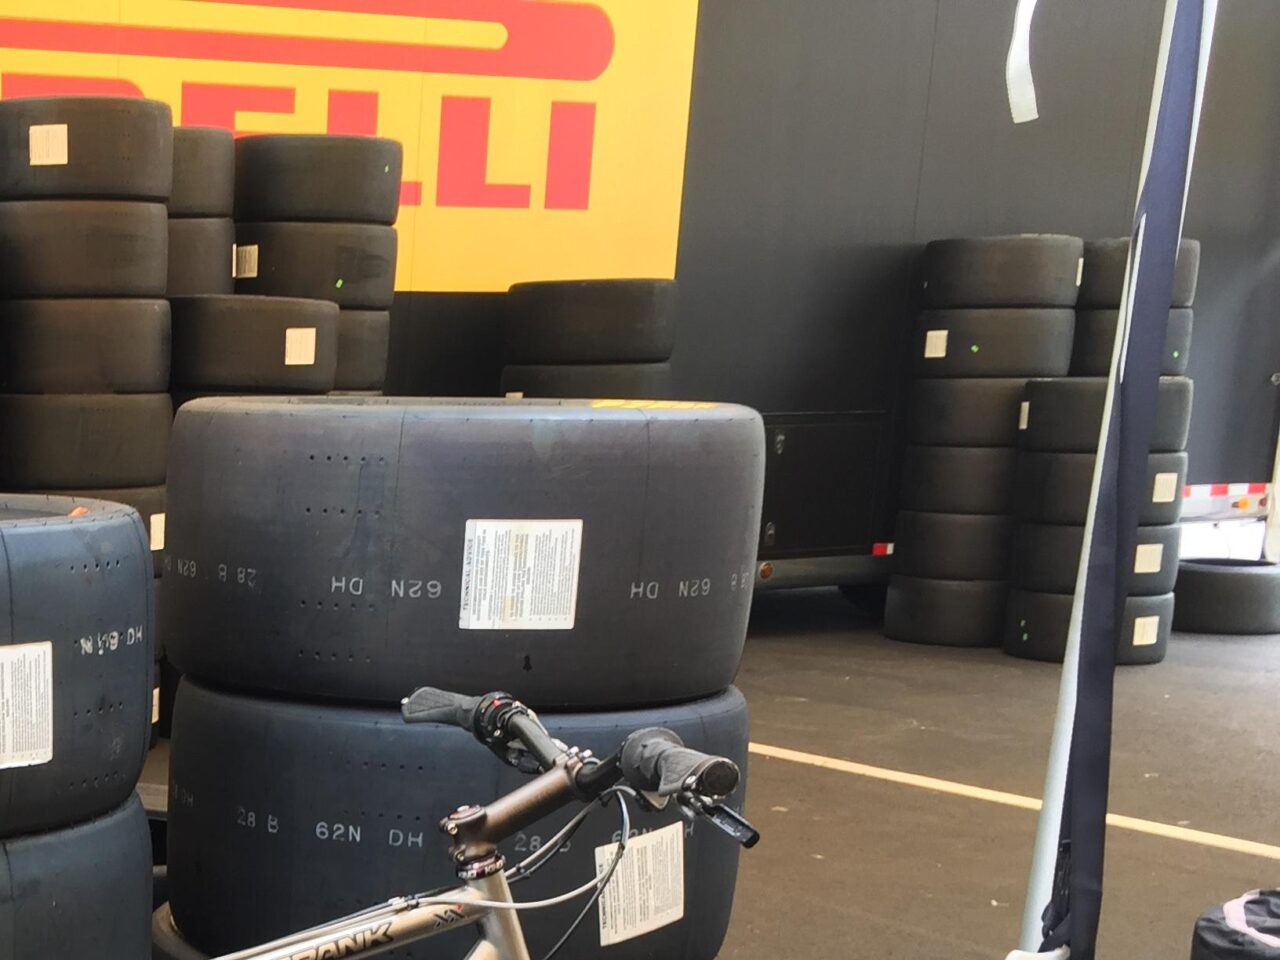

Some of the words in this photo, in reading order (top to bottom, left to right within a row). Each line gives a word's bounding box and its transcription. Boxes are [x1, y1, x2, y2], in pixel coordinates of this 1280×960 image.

[331, 574, 364, 596] DH
[391, 579, 442, 599] 62N
[630, 580, 659, 601] DH
[678, 578, 711, 599] 62N
[315, 822, 361, 843] 62N
[388, 828, 424, 848] DH
[514, 832, 540, 852] 28
